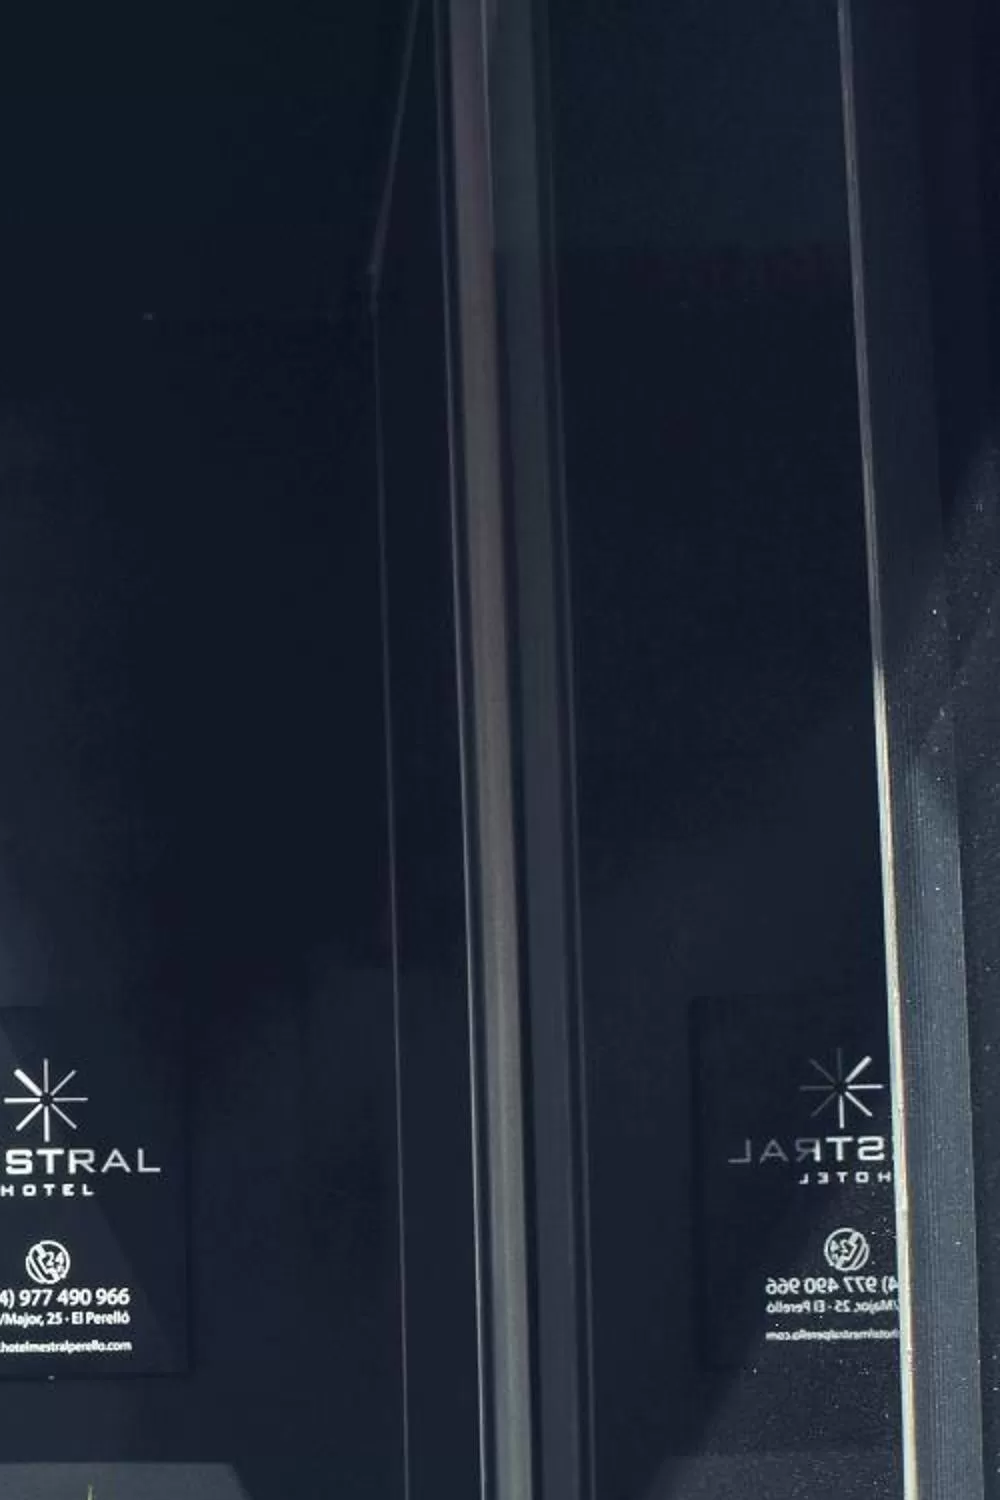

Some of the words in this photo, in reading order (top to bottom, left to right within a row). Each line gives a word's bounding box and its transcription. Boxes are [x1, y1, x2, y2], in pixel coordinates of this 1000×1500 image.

[0, 1183, 94, 1197] HOTEL
[19, 1289, 53, 1307] 977
[56, 1288, 92, 1306] 490
[95, 1288, 131, 1306] 966
[46, 1312, 63, 1325] 25
[71, 1312, 84, 1325] El
[85, 1310, 131, 1325] Perelló
